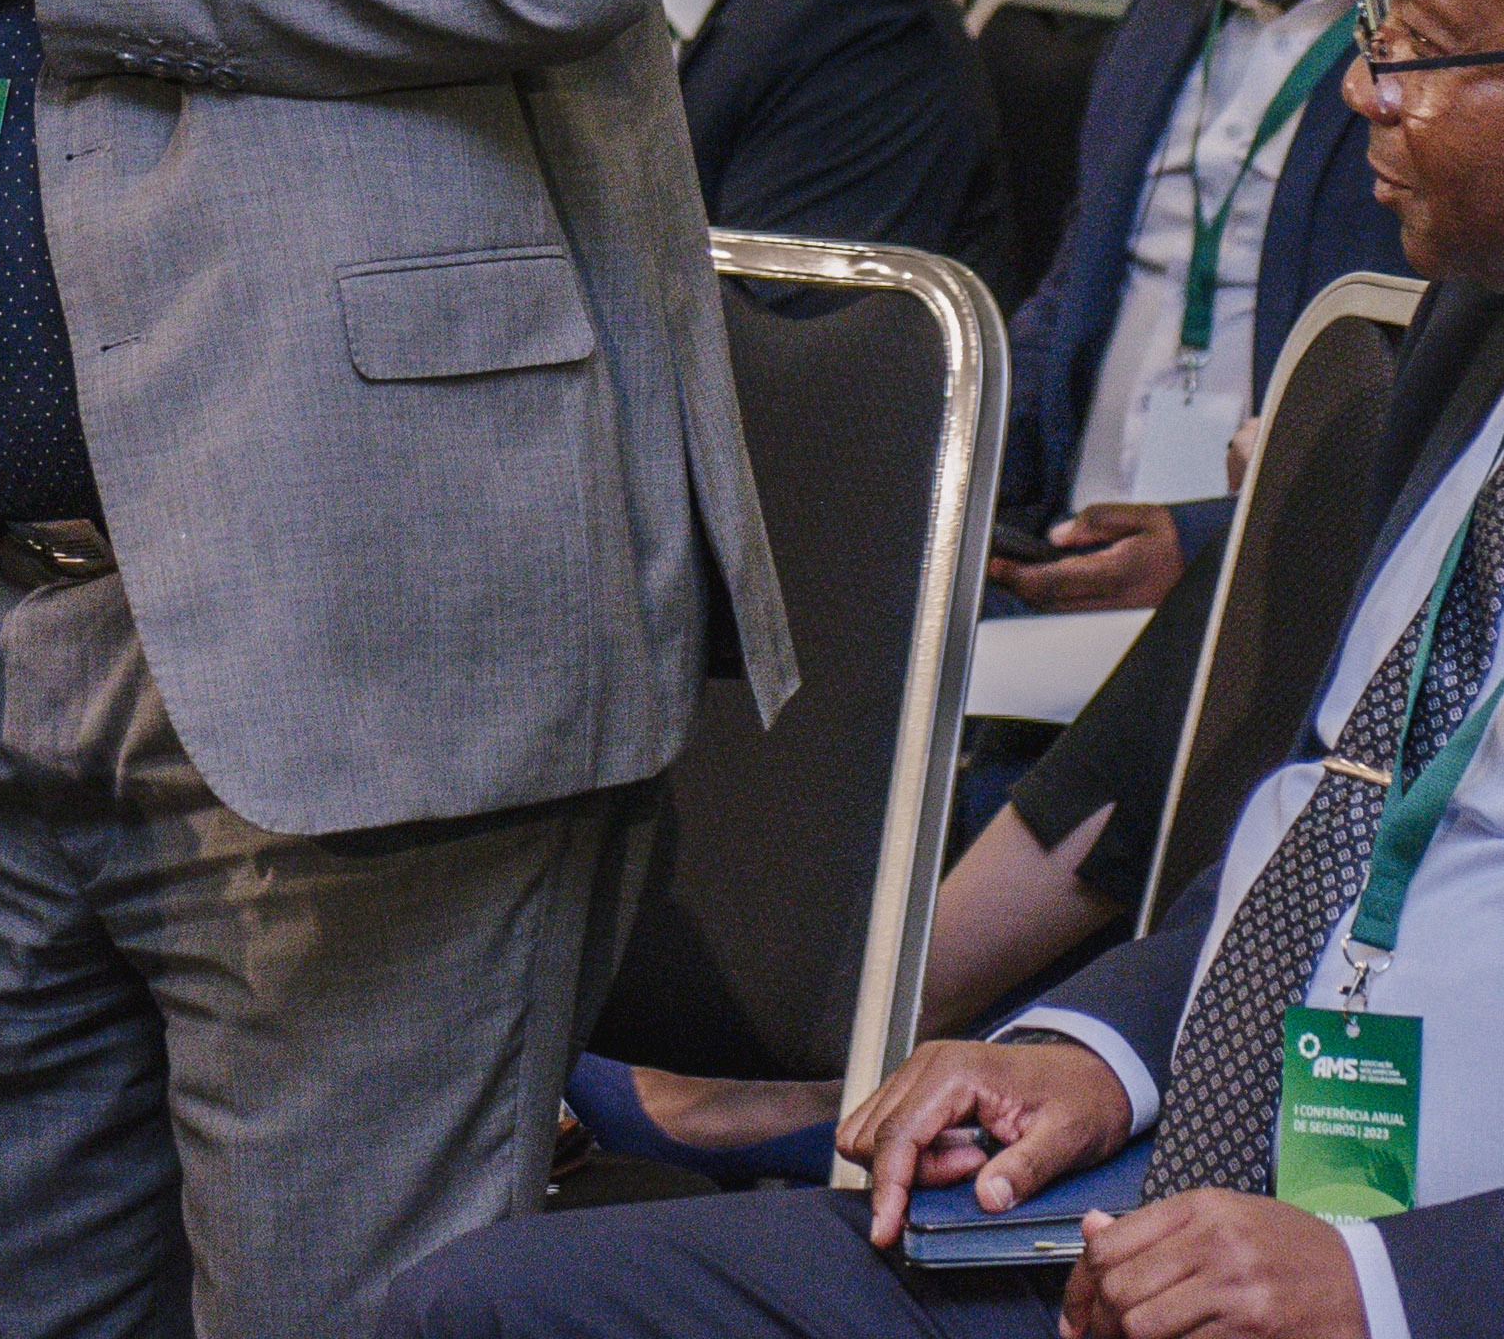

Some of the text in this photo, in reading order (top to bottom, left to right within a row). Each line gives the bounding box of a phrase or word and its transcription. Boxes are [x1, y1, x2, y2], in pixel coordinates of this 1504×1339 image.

[1313, 1056, 1359, 1081] AMS
[1300, 1105, 1370, 1122] CONFERÊNCIA
[1371, 1111, 1406, 1127] ANUAL
[1294, 1119, 1307, 1133] DE
[1310, 1121, 1356, 1137] SEGUROS
[1363, 1127, 1390, 1141] 2023
